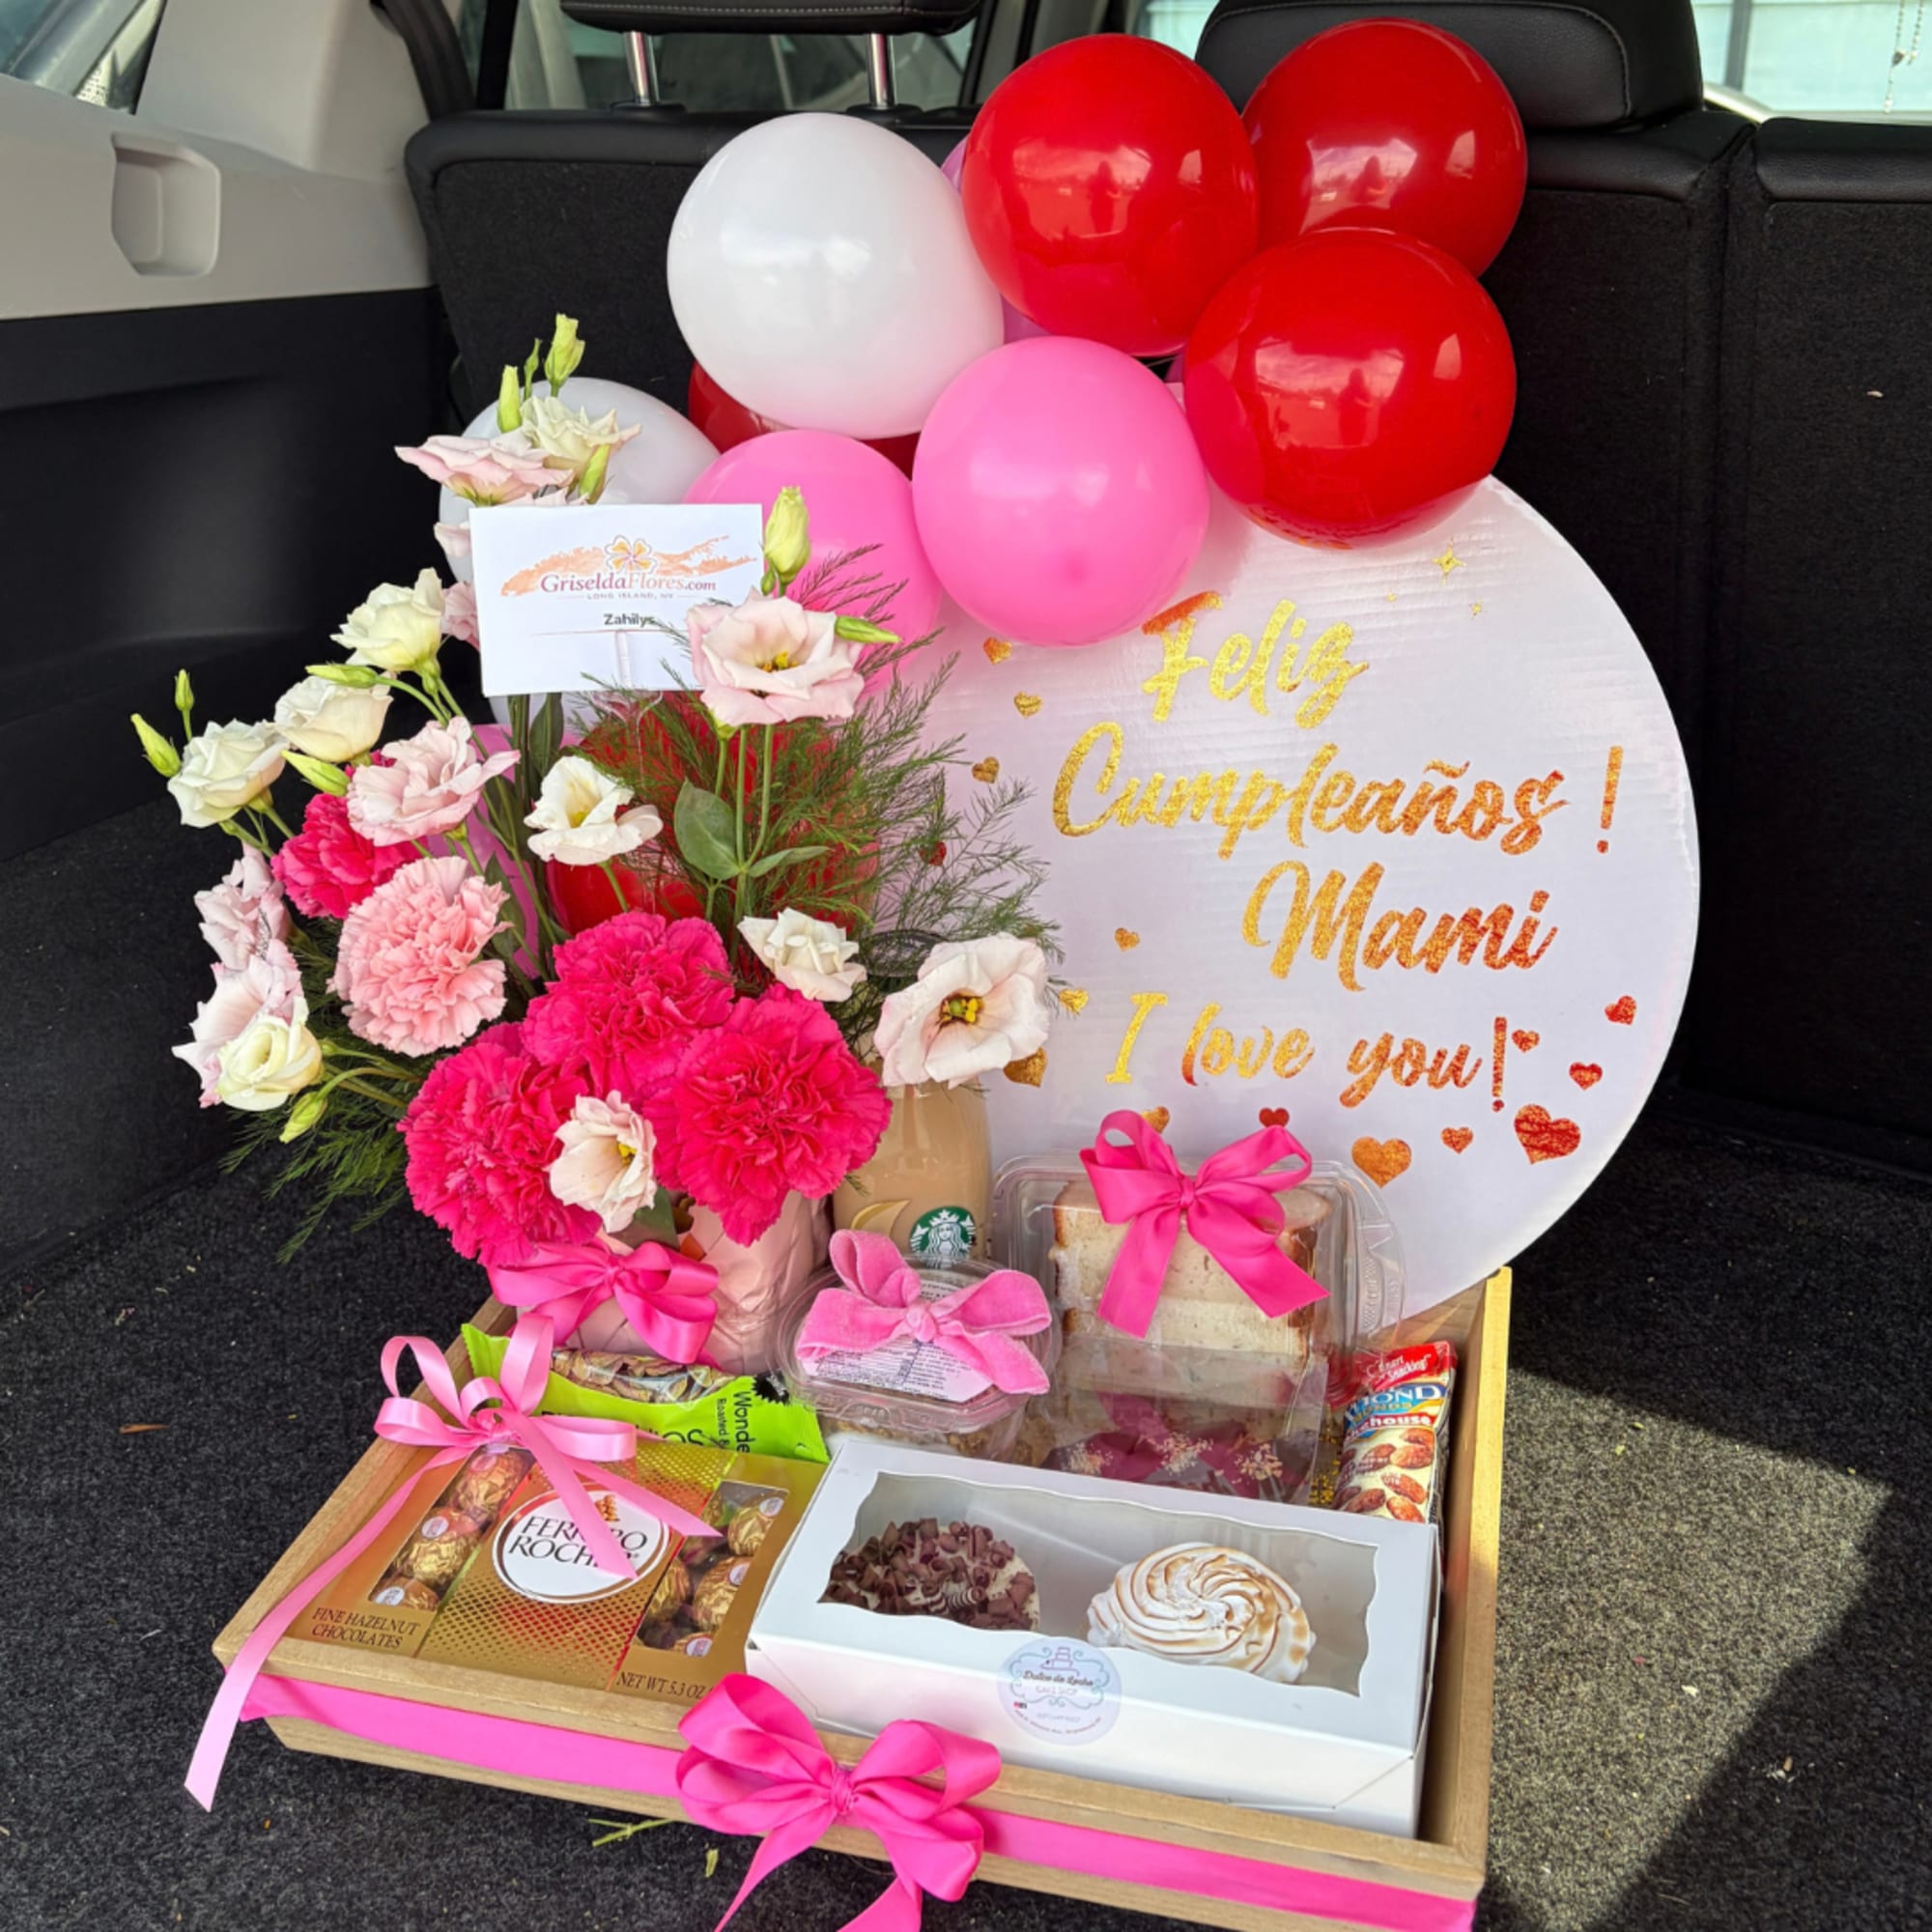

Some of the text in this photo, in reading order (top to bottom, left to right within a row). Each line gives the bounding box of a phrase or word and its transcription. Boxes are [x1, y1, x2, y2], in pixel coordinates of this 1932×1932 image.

[541, 572, 716, 592] GriseldaFlores.com
[604, 613, 656, 628] Zahilys
[1141, 590, 1369, 729] Feliz
[1052, 721, 1571, 860] Cumpleaños
[1241, 860, 1558, 992] Mami
[1105, 991, 1169, 1084] I
[1180, 1002, 1315, 1087] love
[523, 1516, 648, 1551] FERO
[508, 1535, 632, 1568] ROCH
[312, 1607, 421, 1636] FINE HAZELNUT
[312, 1624, 403, 1649] CHOCOLATES
[616, 1670, 646, 1688] NET
[647, 1676, 669, 1693] WT
[686, 1684, 706, 1700] OZ
